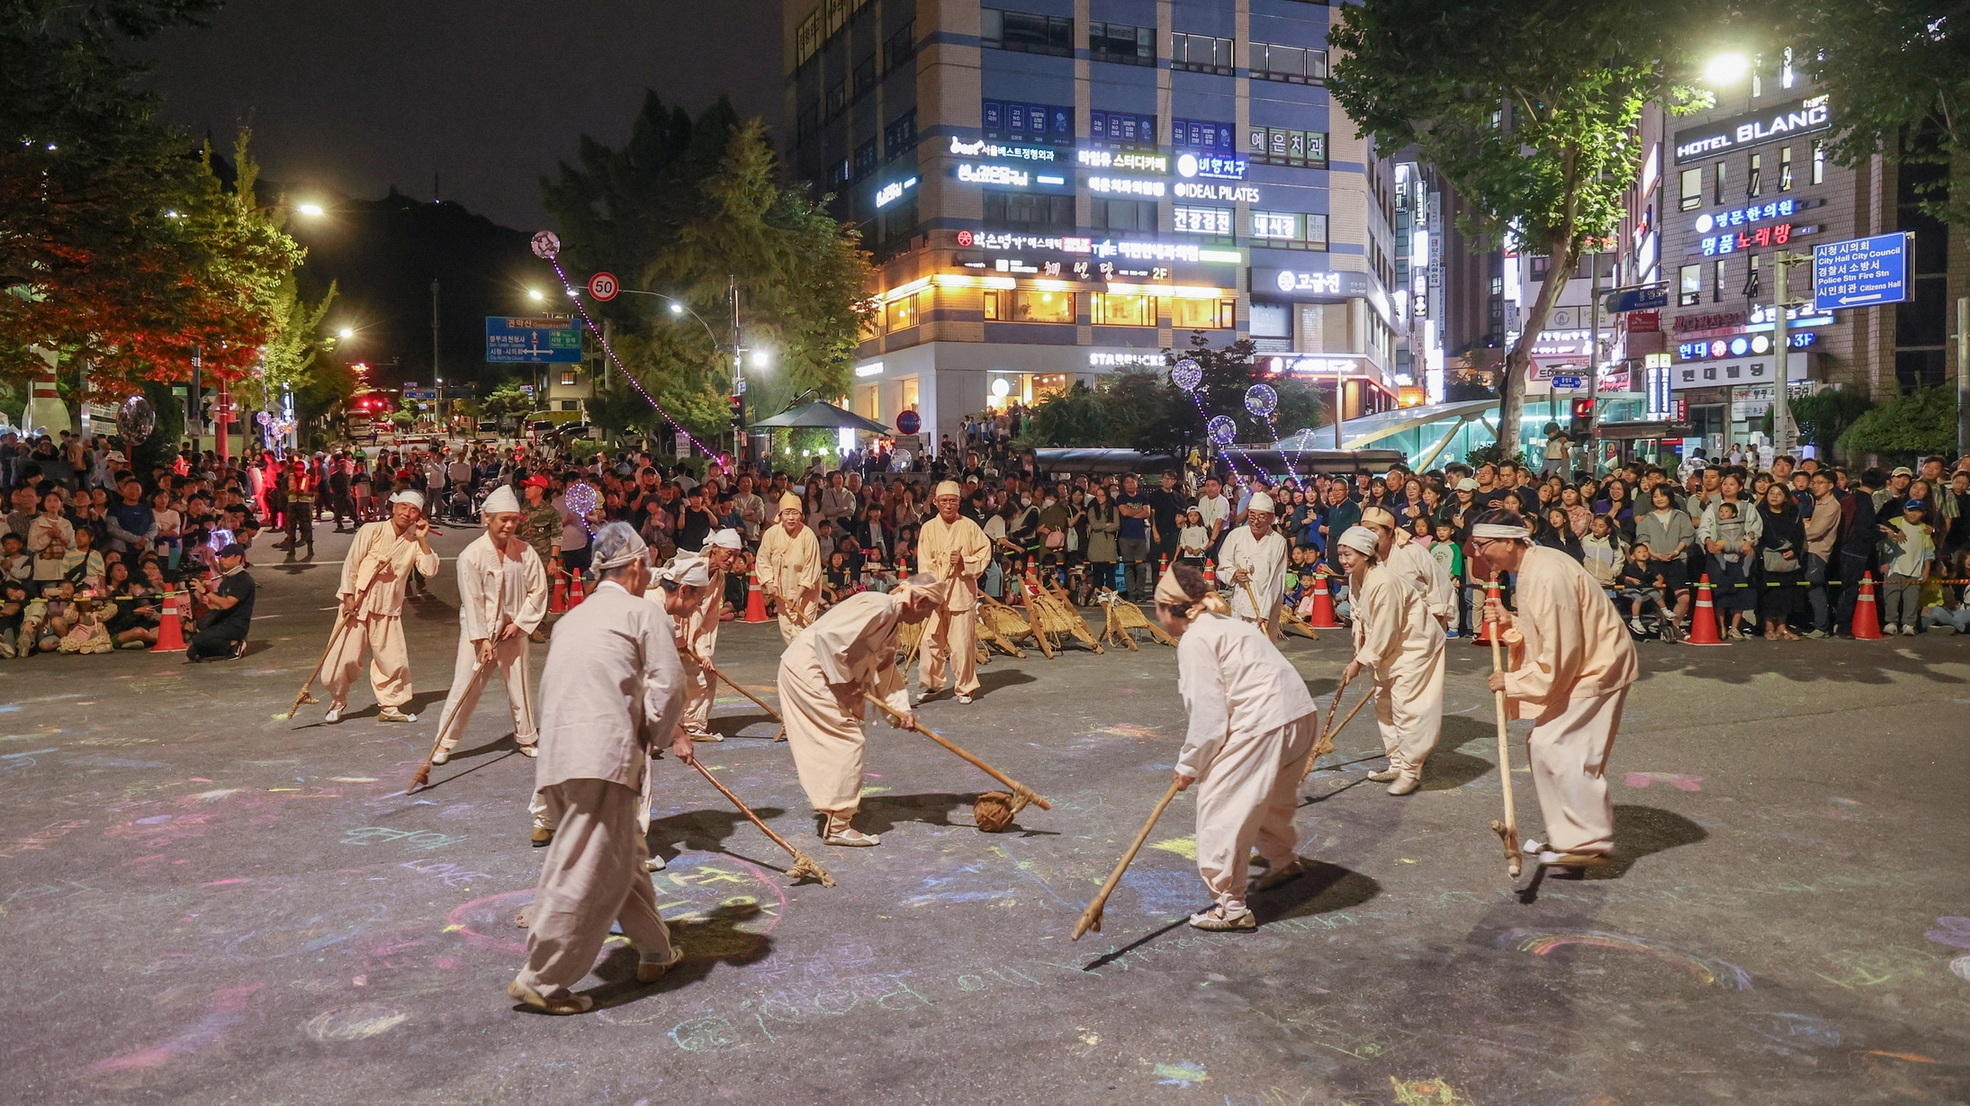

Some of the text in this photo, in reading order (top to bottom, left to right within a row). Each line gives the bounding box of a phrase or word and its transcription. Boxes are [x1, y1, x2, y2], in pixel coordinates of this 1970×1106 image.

[1677, 105, 1827, 158] HOTEL BLANC
[981, 145, 1055, 162] 서울베스트정형외과
[1251, 132, 1324, 156] 예은치과
[1112, 154, 1167, 173] 스터디카페
[1198, 157, 1246, 175] 비행지구
[1185, 183, 1260, 203] IDEAL PILATES
[1173, 211, 1230, 232] 건강검진
[1715, 199, 1794, 228] 명문한의원
[1254, 216, 1295, 236] 내시경
[973, 231, 1023, 251] 약손명가
[1701, 223, 1792, 257] 명품노래방
[1818, 240, 1870, 257] 시청 시의회
[1818, 246, 1901, 266] City Hall City Council
[1152, 267, 1168, 281] 2F
[1818, 259, 1880, 277] 경찰서 소방서
[1818, 269, 1890, 285] Police Stn Fire Stn
[595, 281, 613, 294] 50
[1818, 280, 1902, 297] 시민회관 Citizens Hall
[507, 319, 532, 328] 관악산
[1794, 332, 1815, 348] 3F
[1679, 341, 1708, 360] 현대
[1682, 363, 1764, 383] 현대빌딩
